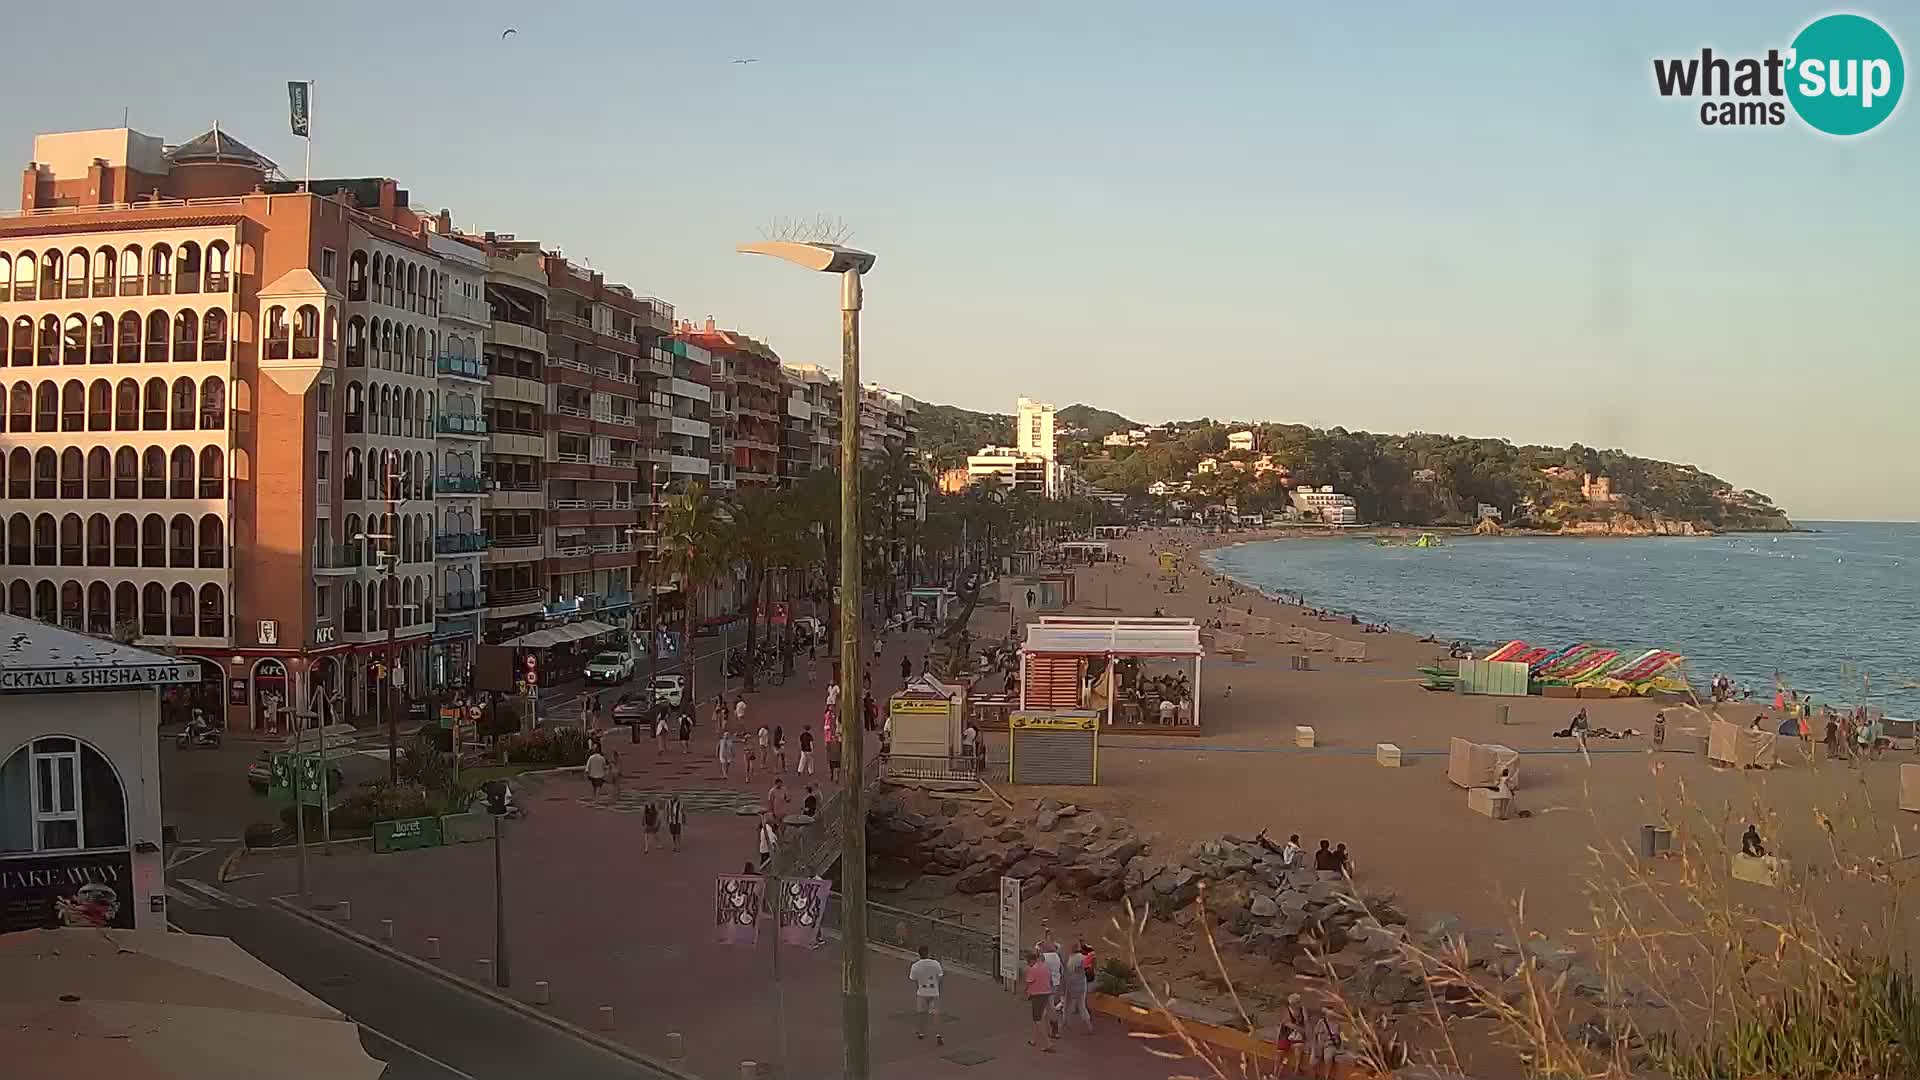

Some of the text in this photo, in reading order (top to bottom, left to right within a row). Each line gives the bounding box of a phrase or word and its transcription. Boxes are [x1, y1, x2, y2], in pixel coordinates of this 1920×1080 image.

[315, 627, 334, 643] KFC
[65, 671, 76, 685] &
[81, 669, 142, 685] SHISHA
[147, 667, 181, 682] BAR
[260, 665, 283, 676] KFC
[1, 864, 124, 889] TAKE AWAY
